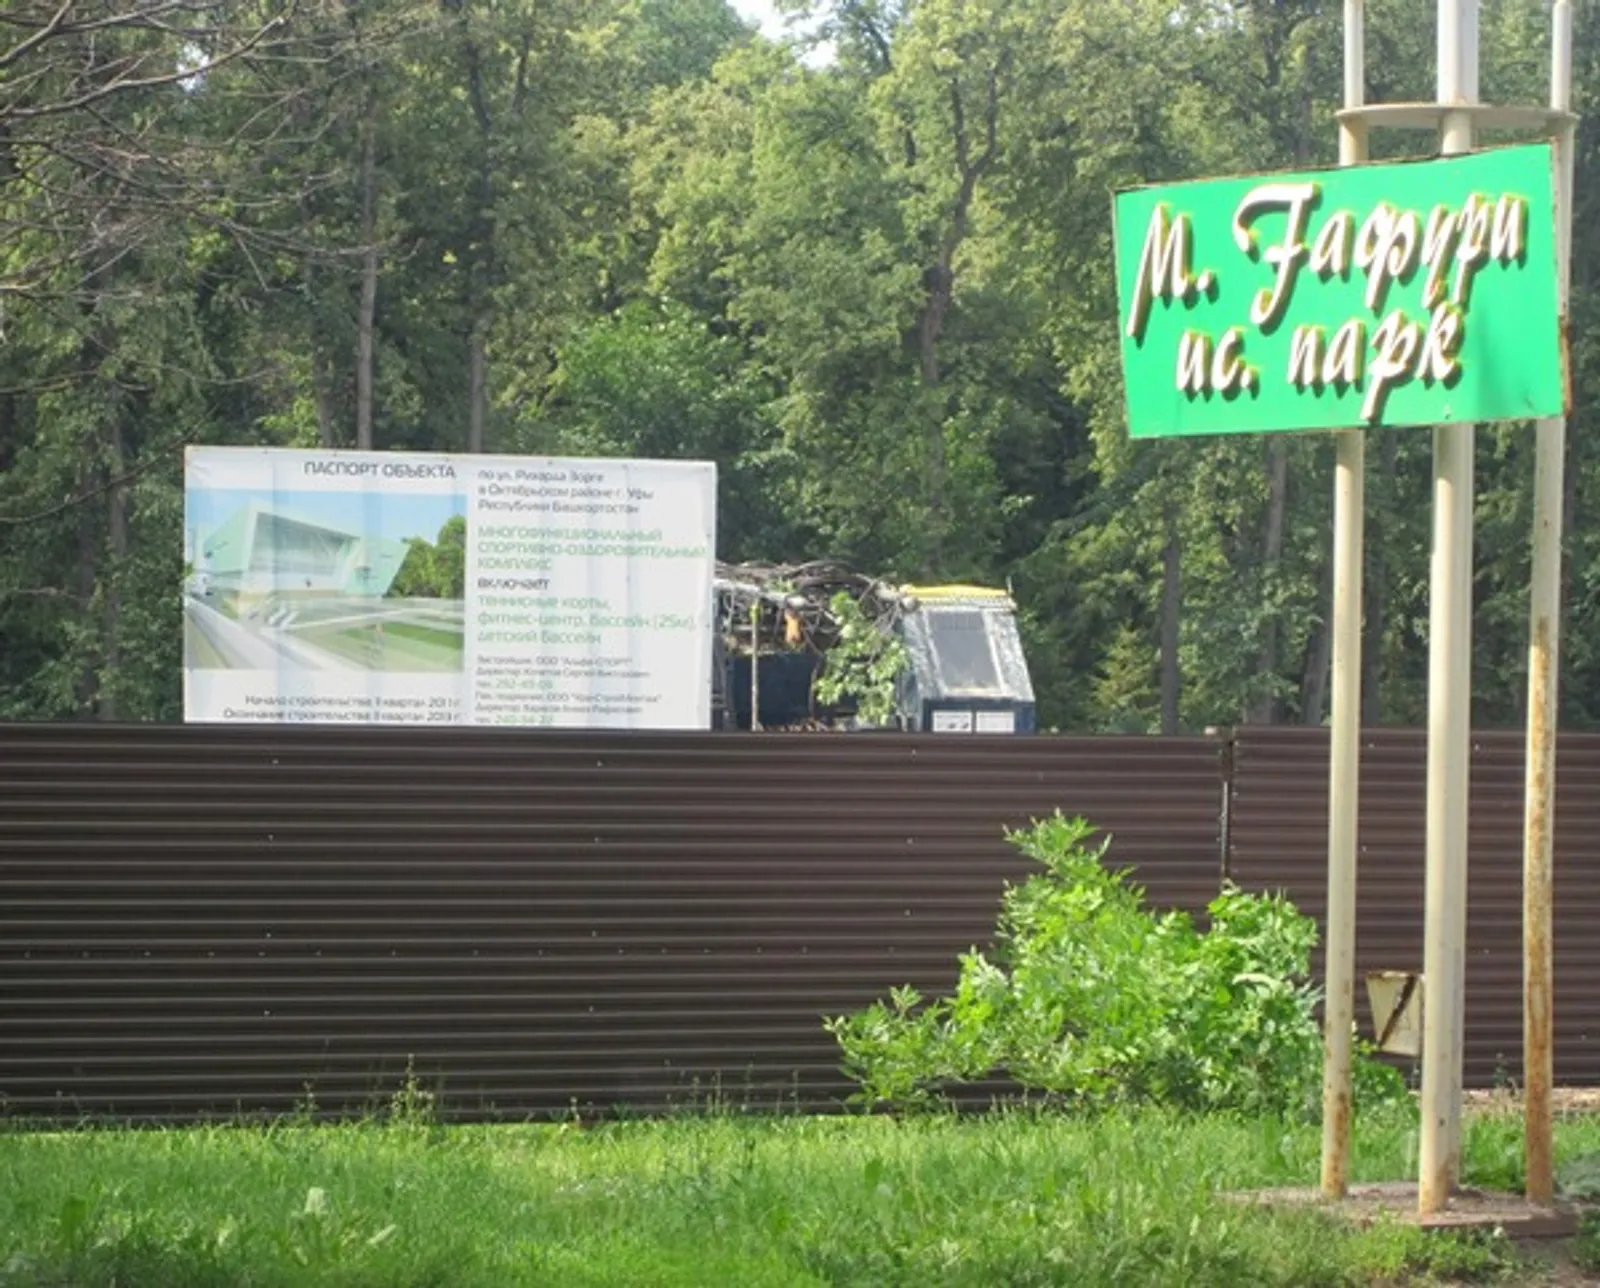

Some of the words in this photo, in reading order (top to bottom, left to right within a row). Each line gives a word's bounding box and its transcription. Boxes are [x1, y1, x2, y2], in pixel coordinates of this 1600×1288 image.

[1126, 202, 1215, 338] М.
[1176, 329, 1256, 393] ис.
[1288, 302, 1464, 422] парк
[304, 463, 378, 478] ПАСПОРТ
[381, 464, 457, 479] ОБЪЕКТА
[488, 484, 568, 498] Октябрьском
[571, 487, 613, 500] районе
[627, 488, 655, 501] Уфы
[478, 499, 551, 513] Республики
[552, 501, 640, 515] Башкортостан
[478, 526, 663, 541] МНОГОФУНКЦИОНАЛЬНЫЙ
[478, 558, 553, 570] КОМПЛЕКС
